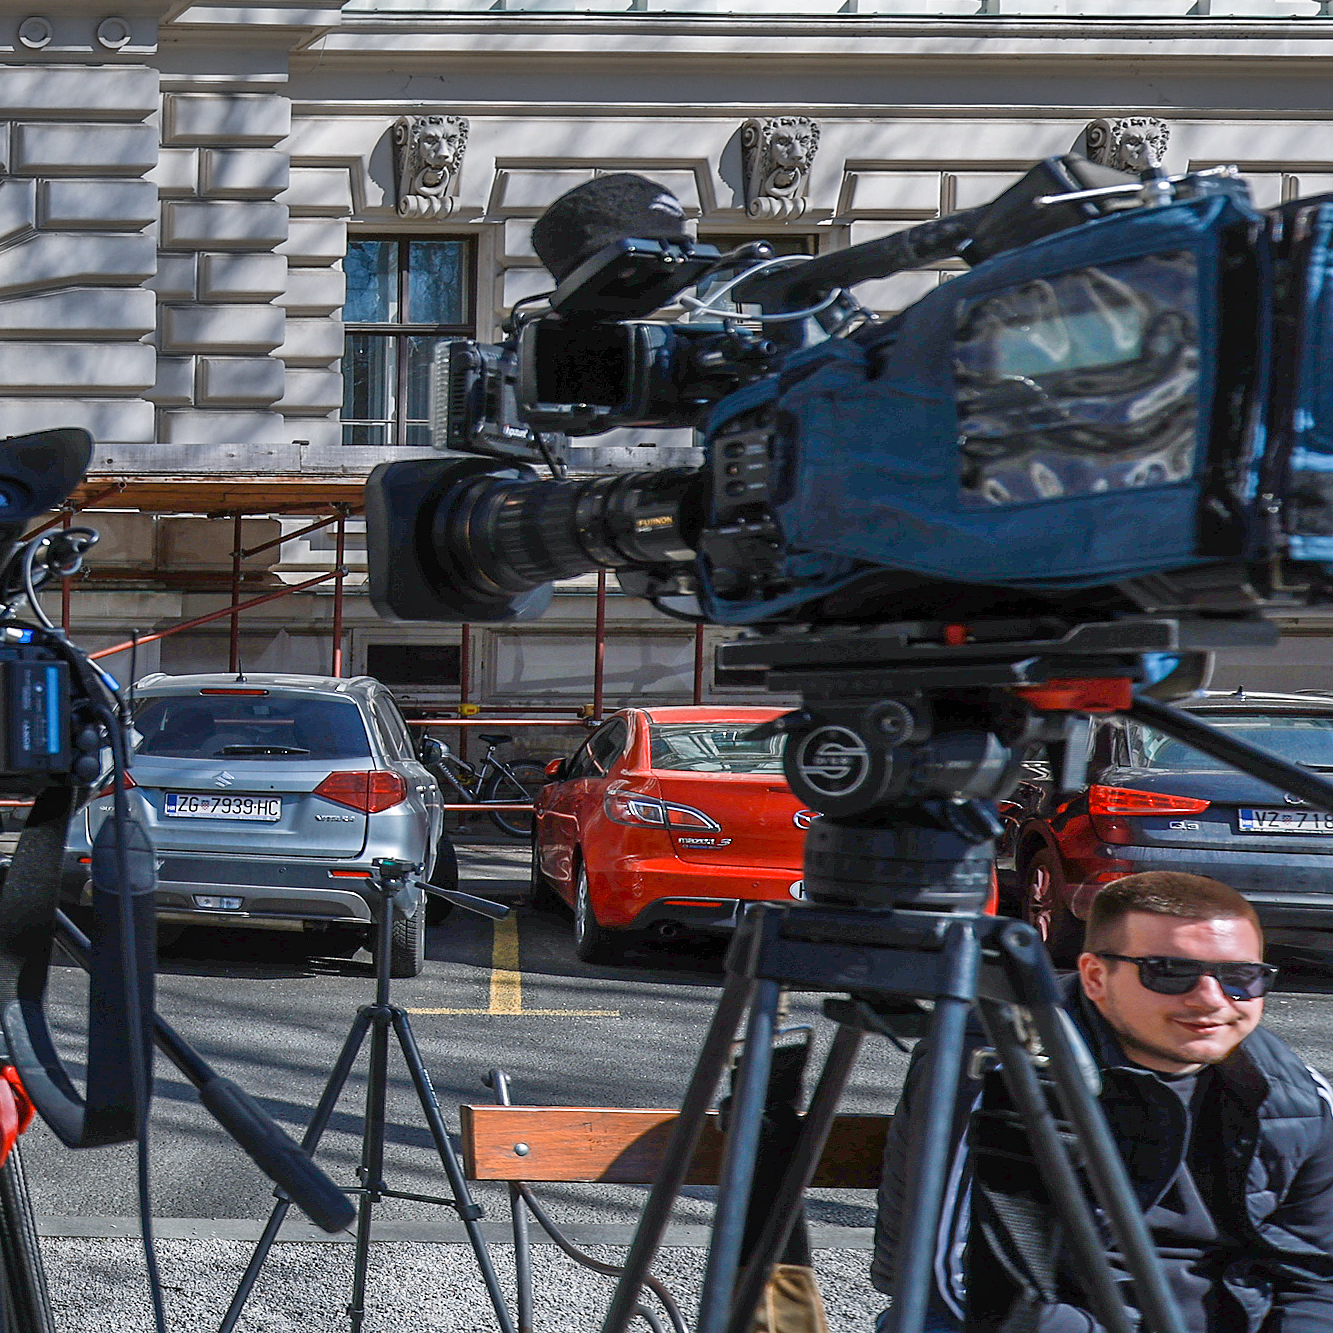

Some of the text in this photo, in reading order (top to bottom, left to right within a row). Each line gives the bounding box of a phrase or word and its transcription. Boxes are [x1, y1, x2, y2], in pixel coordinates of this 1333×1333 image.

[637, 516, 673, 527] FUJINON
[177, 796, 199, 812] ZG
[1169, 820, 1200, 831] Q3
[1255, 811, 1279, 828] VZ
